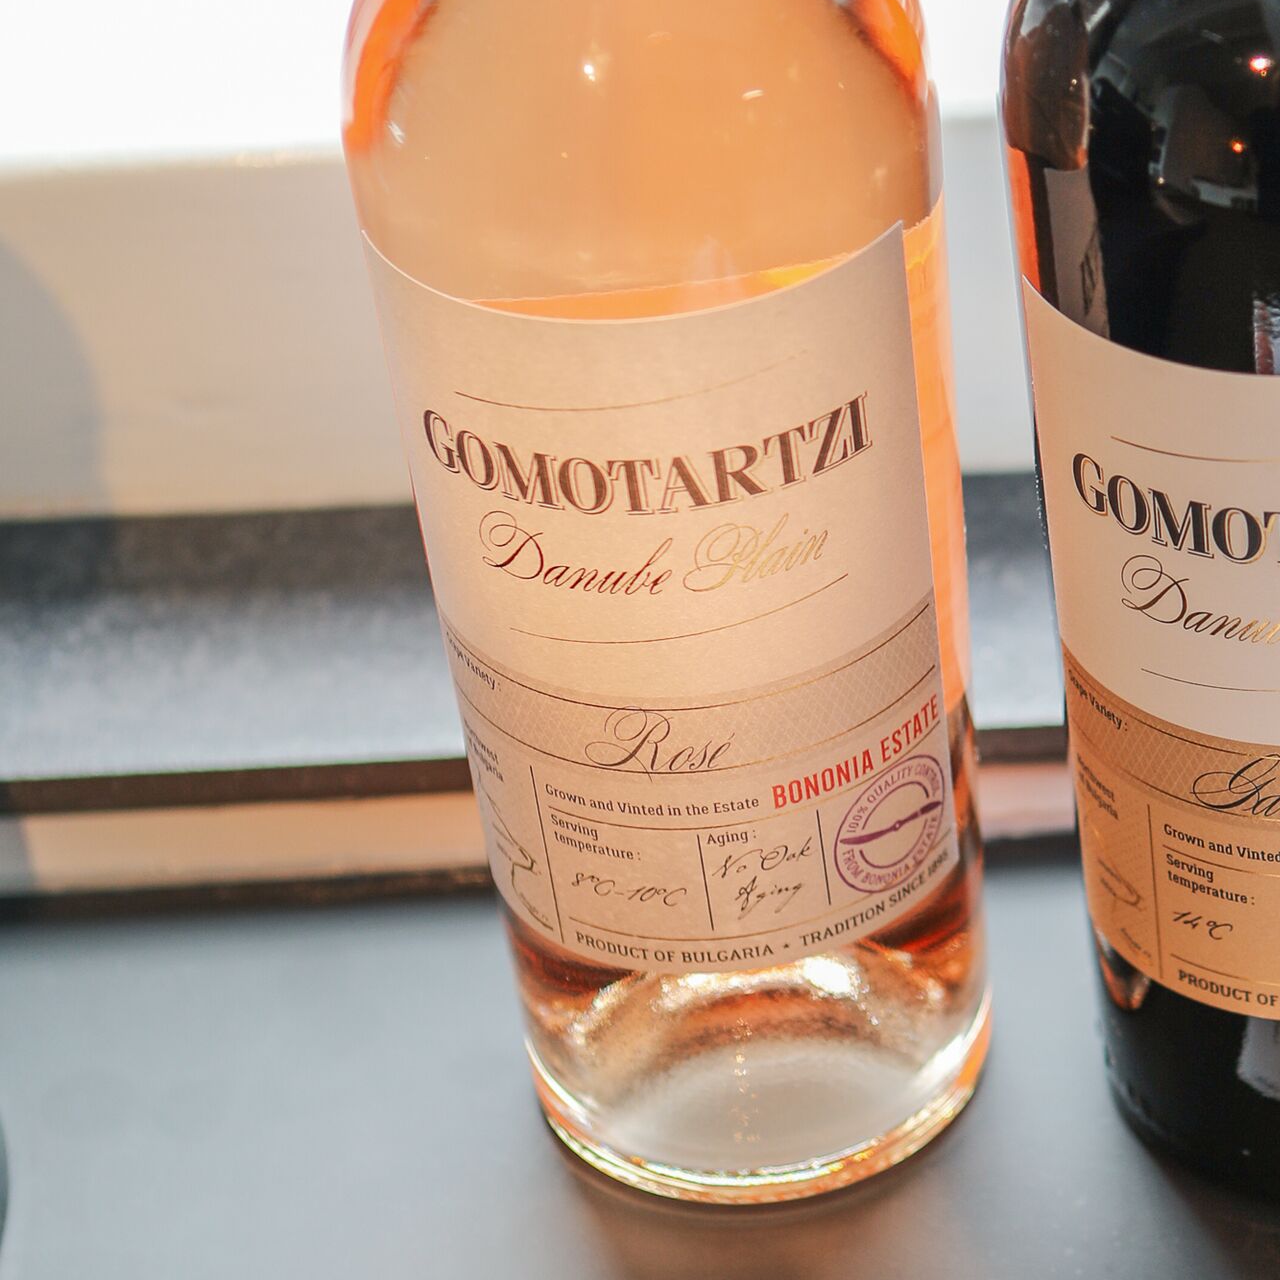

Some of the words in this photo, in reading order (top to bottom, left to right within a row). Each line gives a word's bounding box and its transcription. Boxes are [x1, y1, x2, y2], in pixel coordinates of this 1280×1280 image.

[423, 391, 874, 515] GOMOTARTZI
[479, 510, 674, 595] Danube
[683, 512, 830, 591] Plain
[584, 705, 736, 783] Rosé
[771, 756, 875, 810] BONONIA
[880, 694, 939, 763] ESTATE
[545, 783, 586, 807] Grown
[590, 797, 614, 812] and
[617, 801, 663, 816] Vinted
[667, 803, 682, 816] in
[685, 803, 709, 816] the
[714, 797, 760, 813] Estate
[866, 765, 914, 804] QUALITY
[550, 813, 599, 840] Serving
[1163, 823, 1205, 849] Grown
[1208, 839, 1233, 856] and
[760, 836, 813, 871] Oak
[1165, 853, 1215, 883] Serving
[575, 930, 650, 961] PRODUCT
[653, 949, 676, 963] OF
[681, 943, 774, 965] BULGARIA
[798, 900, 886, 947] TRADITION
[888, 875, 927, 908] SINCE
[1177, 969, 1252, 1003] PRODUCT
[1256, 993, 1279, 1007] OF
